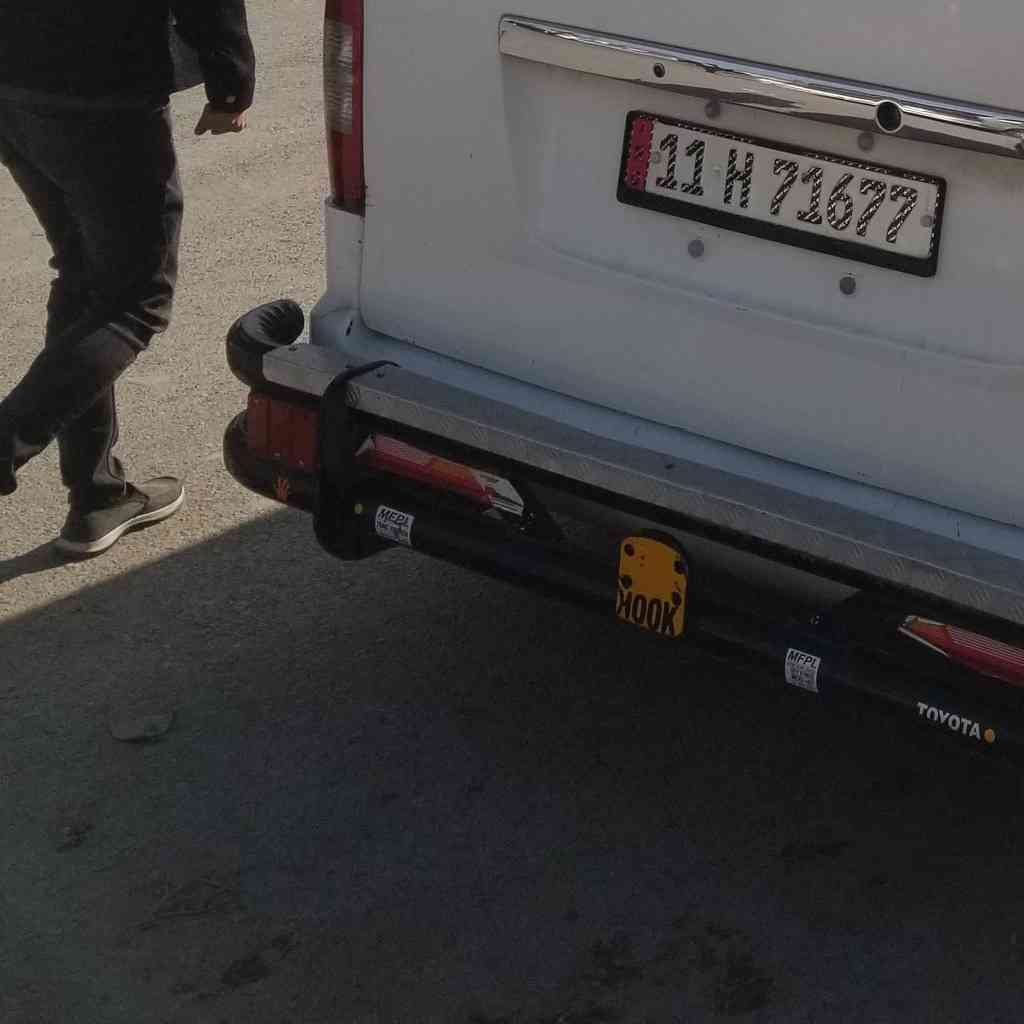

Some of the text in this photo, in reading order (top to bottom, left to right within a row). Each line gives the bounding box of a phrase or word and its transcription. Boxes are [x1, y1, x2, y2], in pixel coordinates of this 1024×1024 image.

[656, 133, 706, 197] 11
[723, 148, 754, 209] H
[769, 156, 918, 244] 71677
[616, 590, 678, 637] HOOK
[917, 700, 982, 741] TOYOTA
